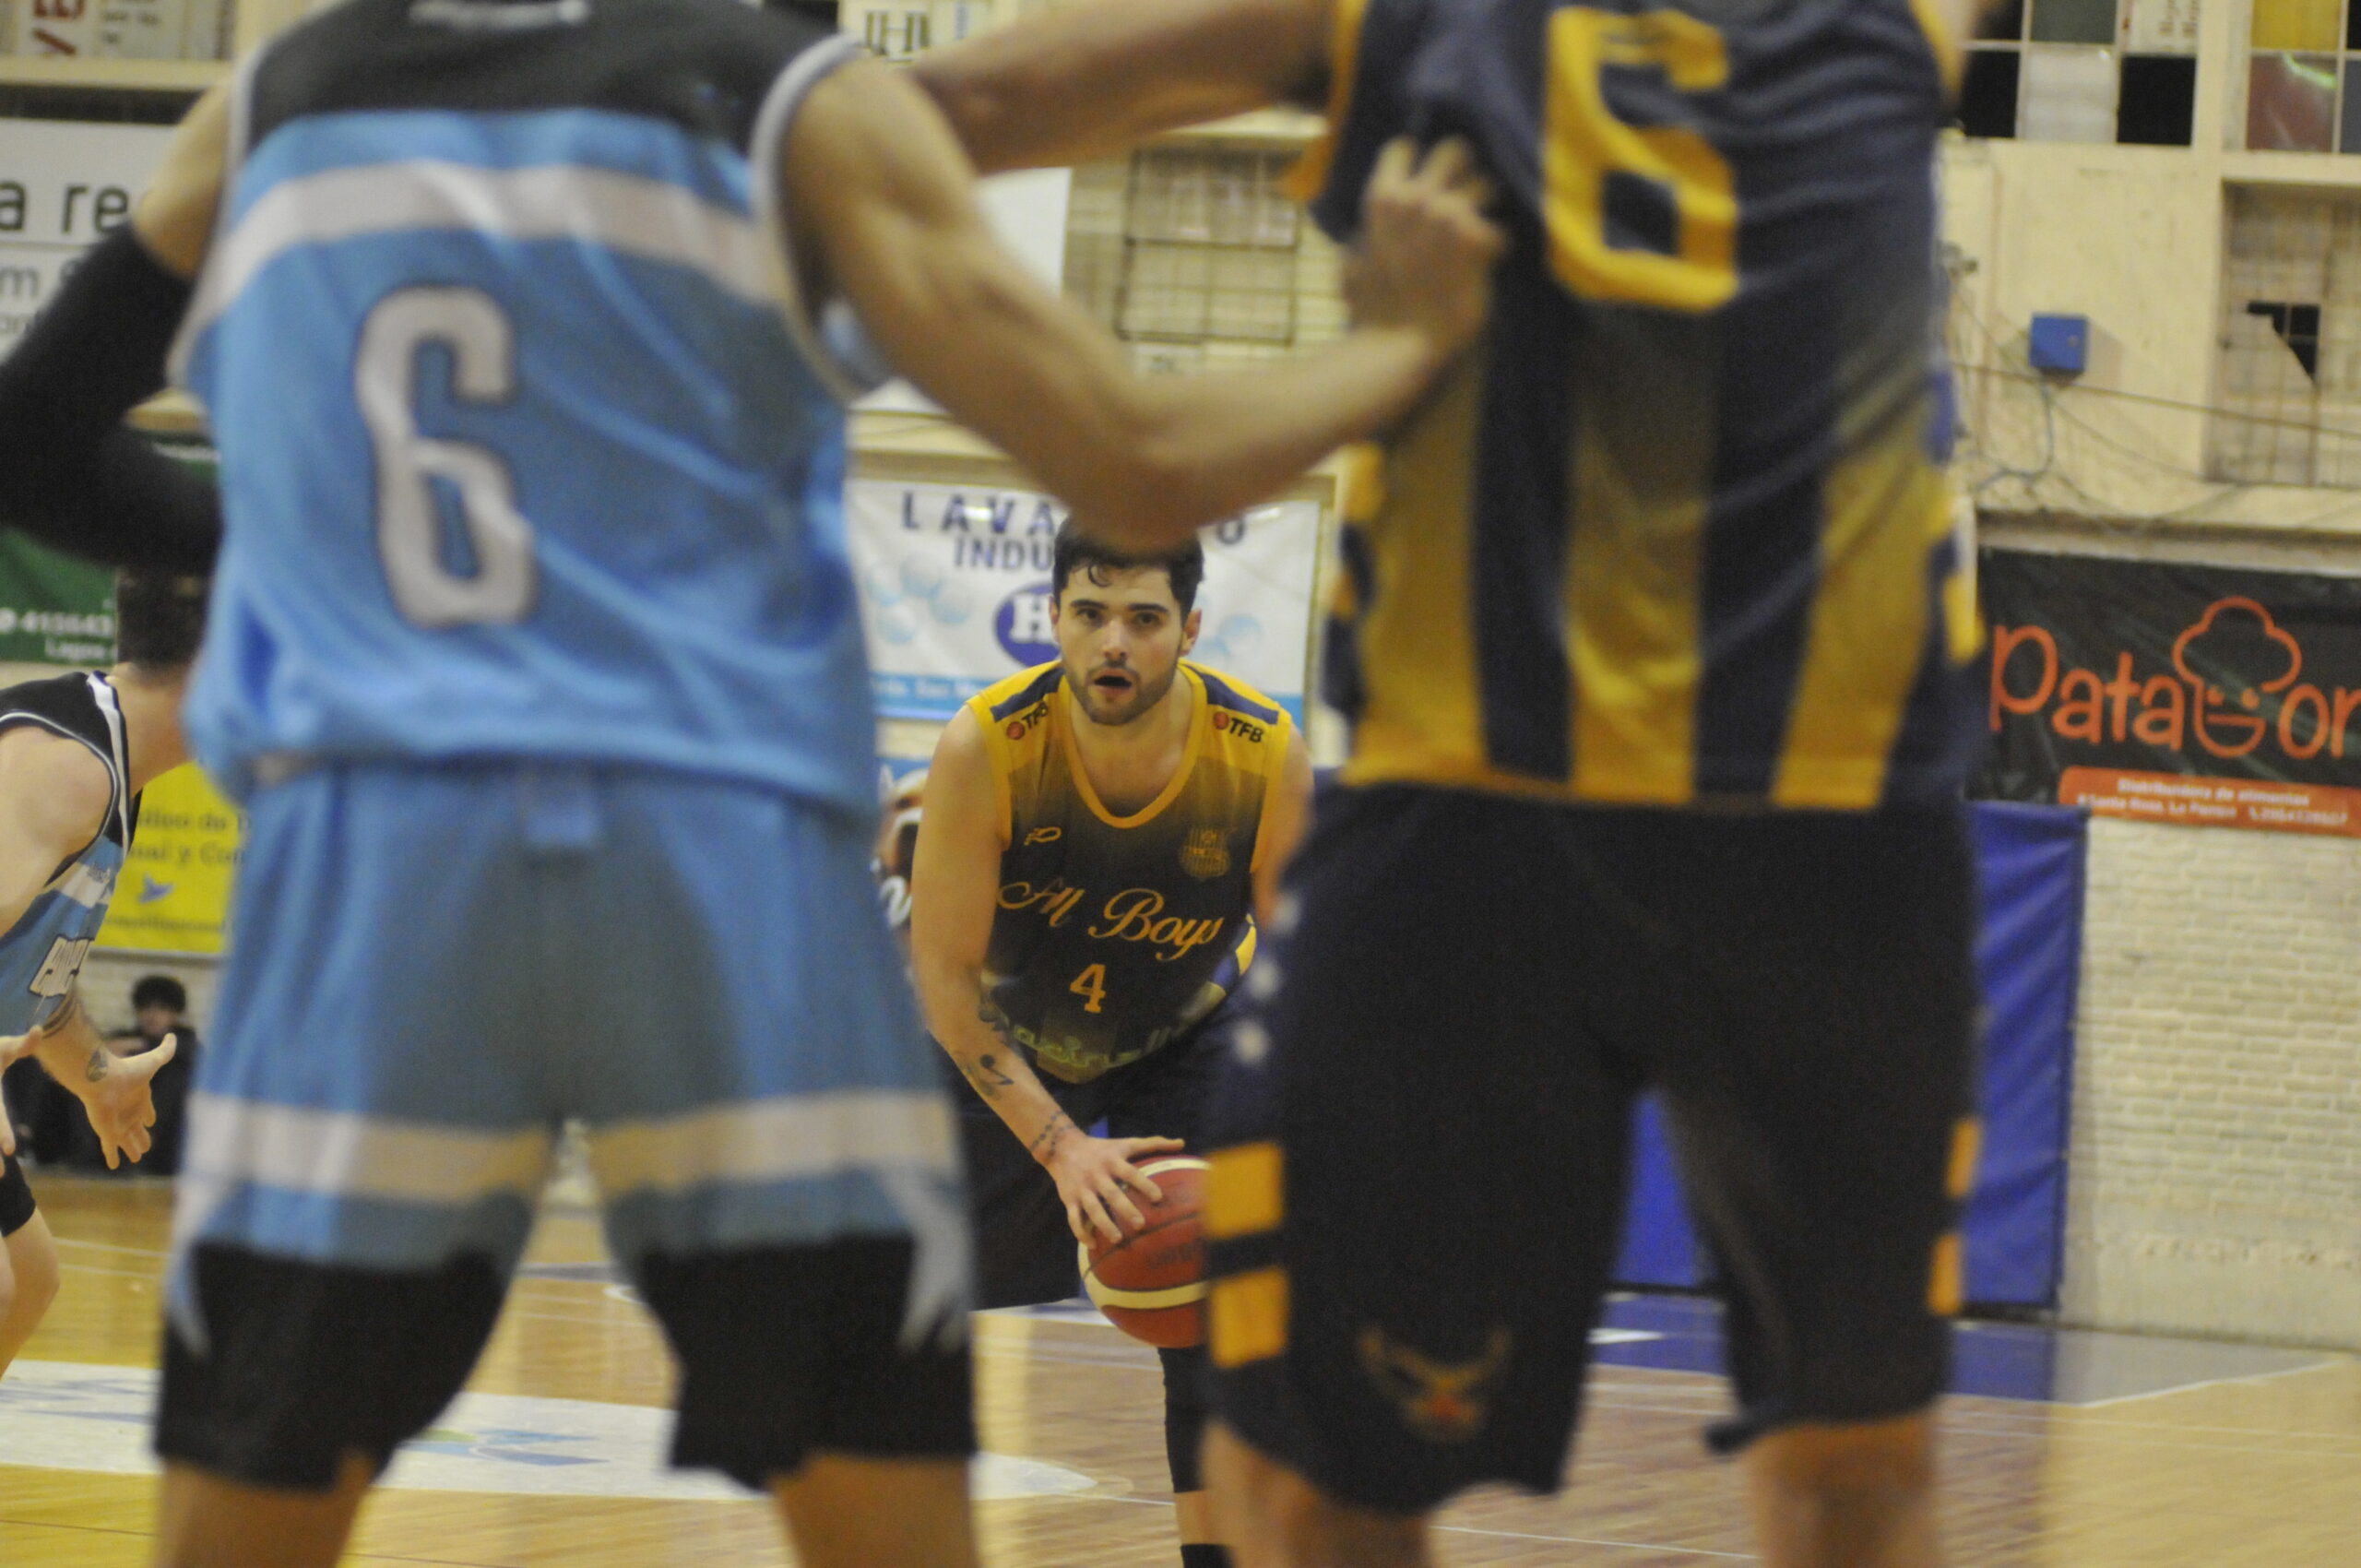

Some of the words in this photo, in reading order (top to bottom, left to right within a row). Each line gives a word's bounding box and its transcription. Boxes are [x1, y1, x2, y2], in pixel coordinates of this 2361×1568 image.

[1543, 7, 1738, 310] 6
[356, 288, 537, 631] 6
[953, 537, 1054, 571] INDU
[1228, 718, 1264, 742] TFB
[1088, 887, 1225, 961] Boys
[1070, 964, 1107, 1013] 4
